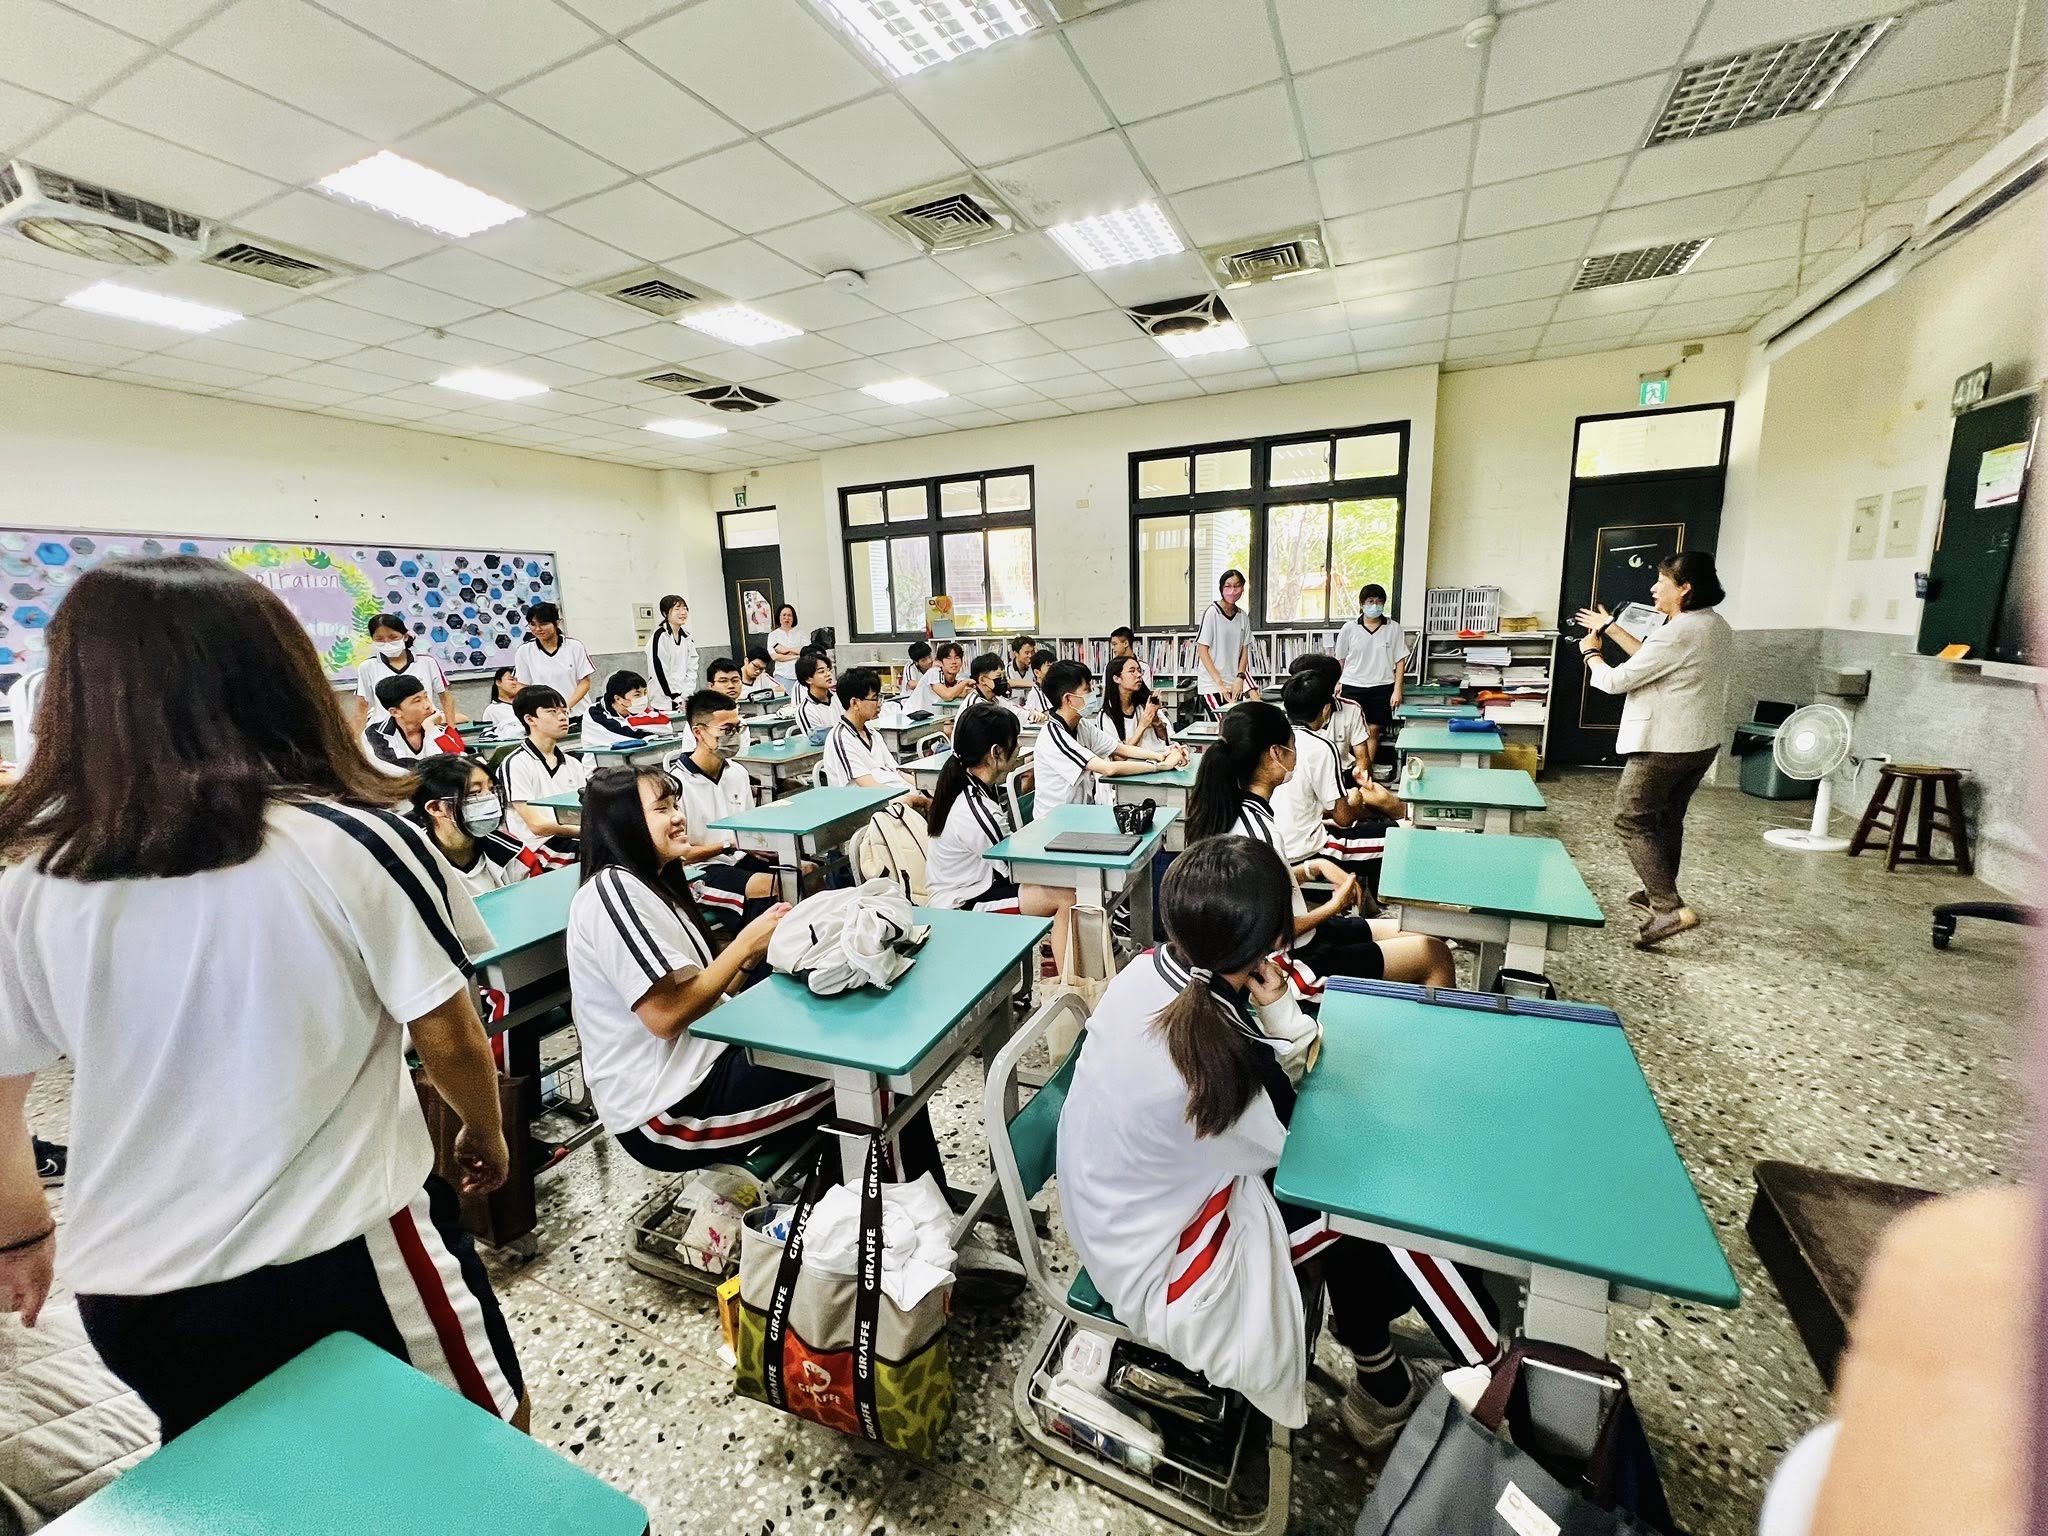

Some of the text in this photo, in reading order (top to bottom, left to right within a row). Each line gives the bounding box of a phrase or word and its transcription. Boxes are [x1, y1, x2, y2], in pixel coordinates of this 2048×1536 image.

[789, 1202, 811, 1259] GIRAFFE
[864, 1228, 876, 1290] GIRAFFE
[770, 1285, 788, 1341] GIRAFFE
[858, 1320, 871, 1379] GIRAFFE
